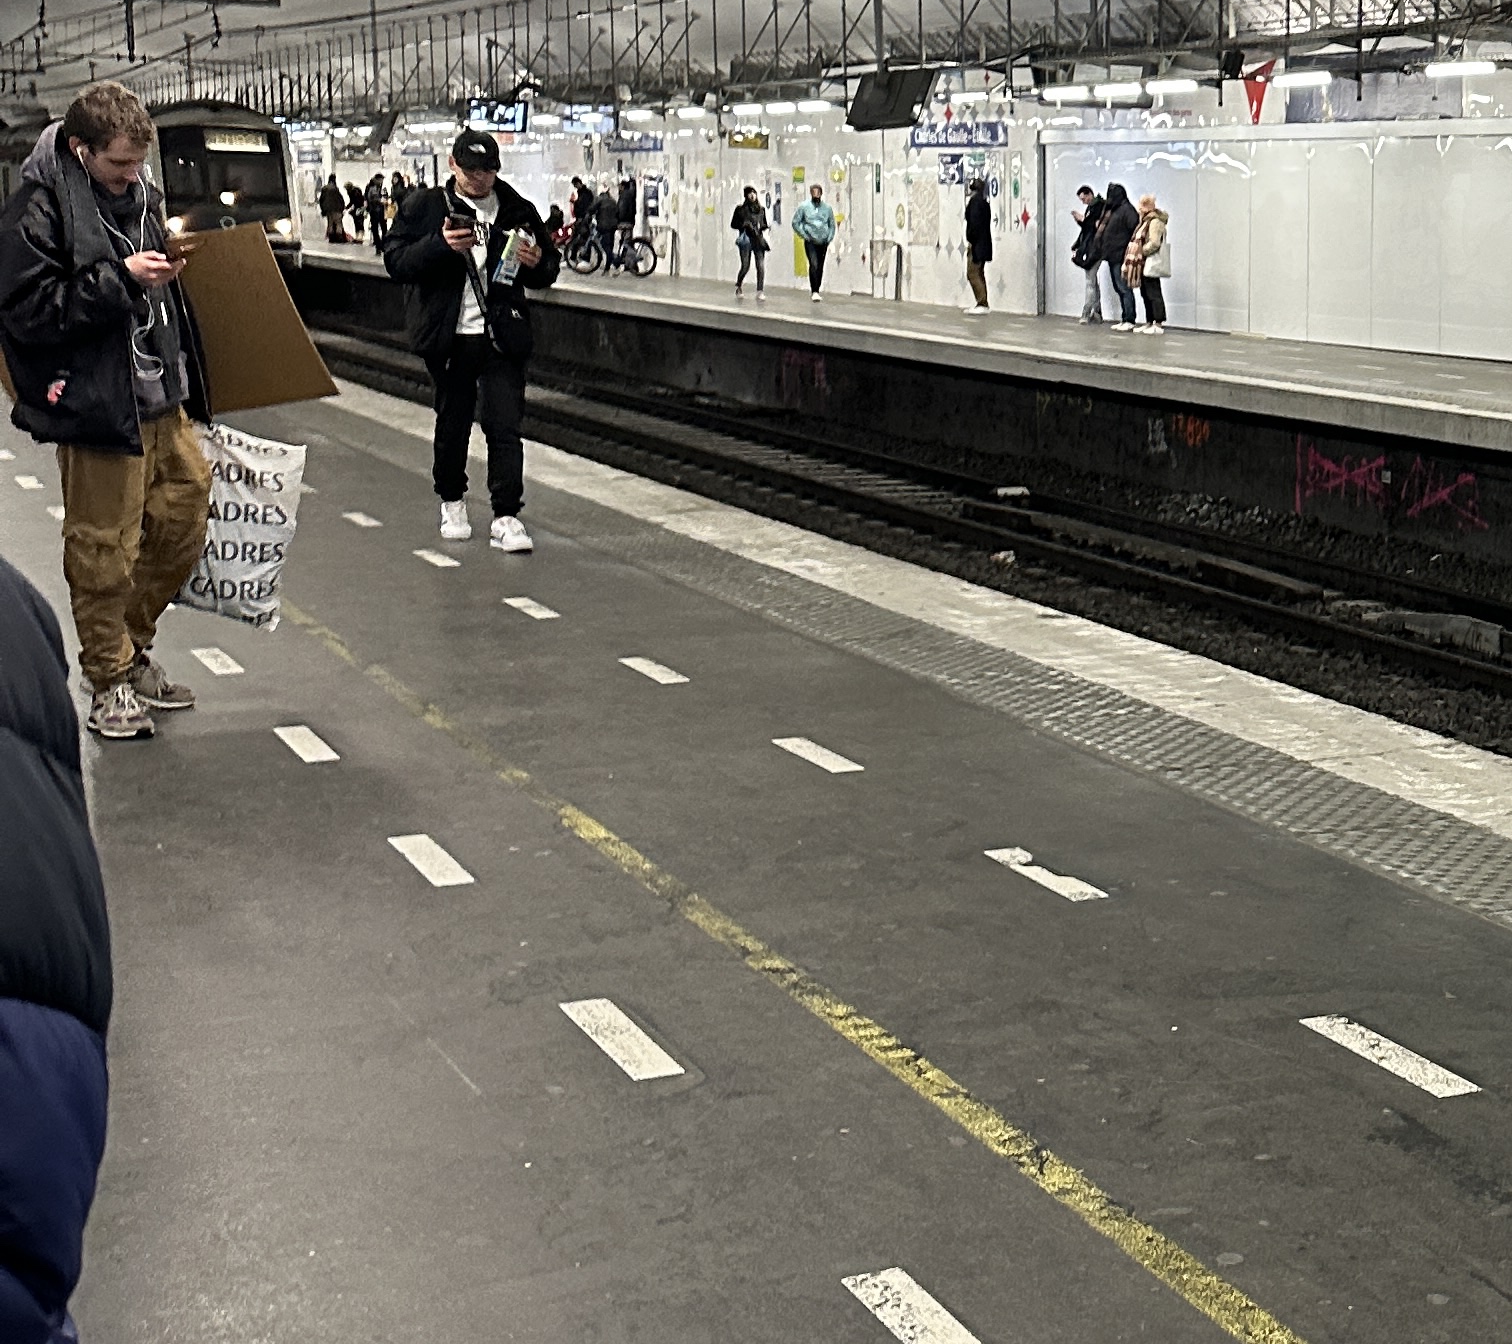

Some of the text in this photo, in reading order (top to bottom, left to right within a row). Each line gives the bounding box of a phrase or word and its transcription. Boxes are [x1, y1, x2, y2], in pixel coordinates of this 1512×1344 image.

[211, 460, 285, 493] ADRES
[208, 499, 287, 526] ADRES
[203, 538, 284, 564] ADRES
